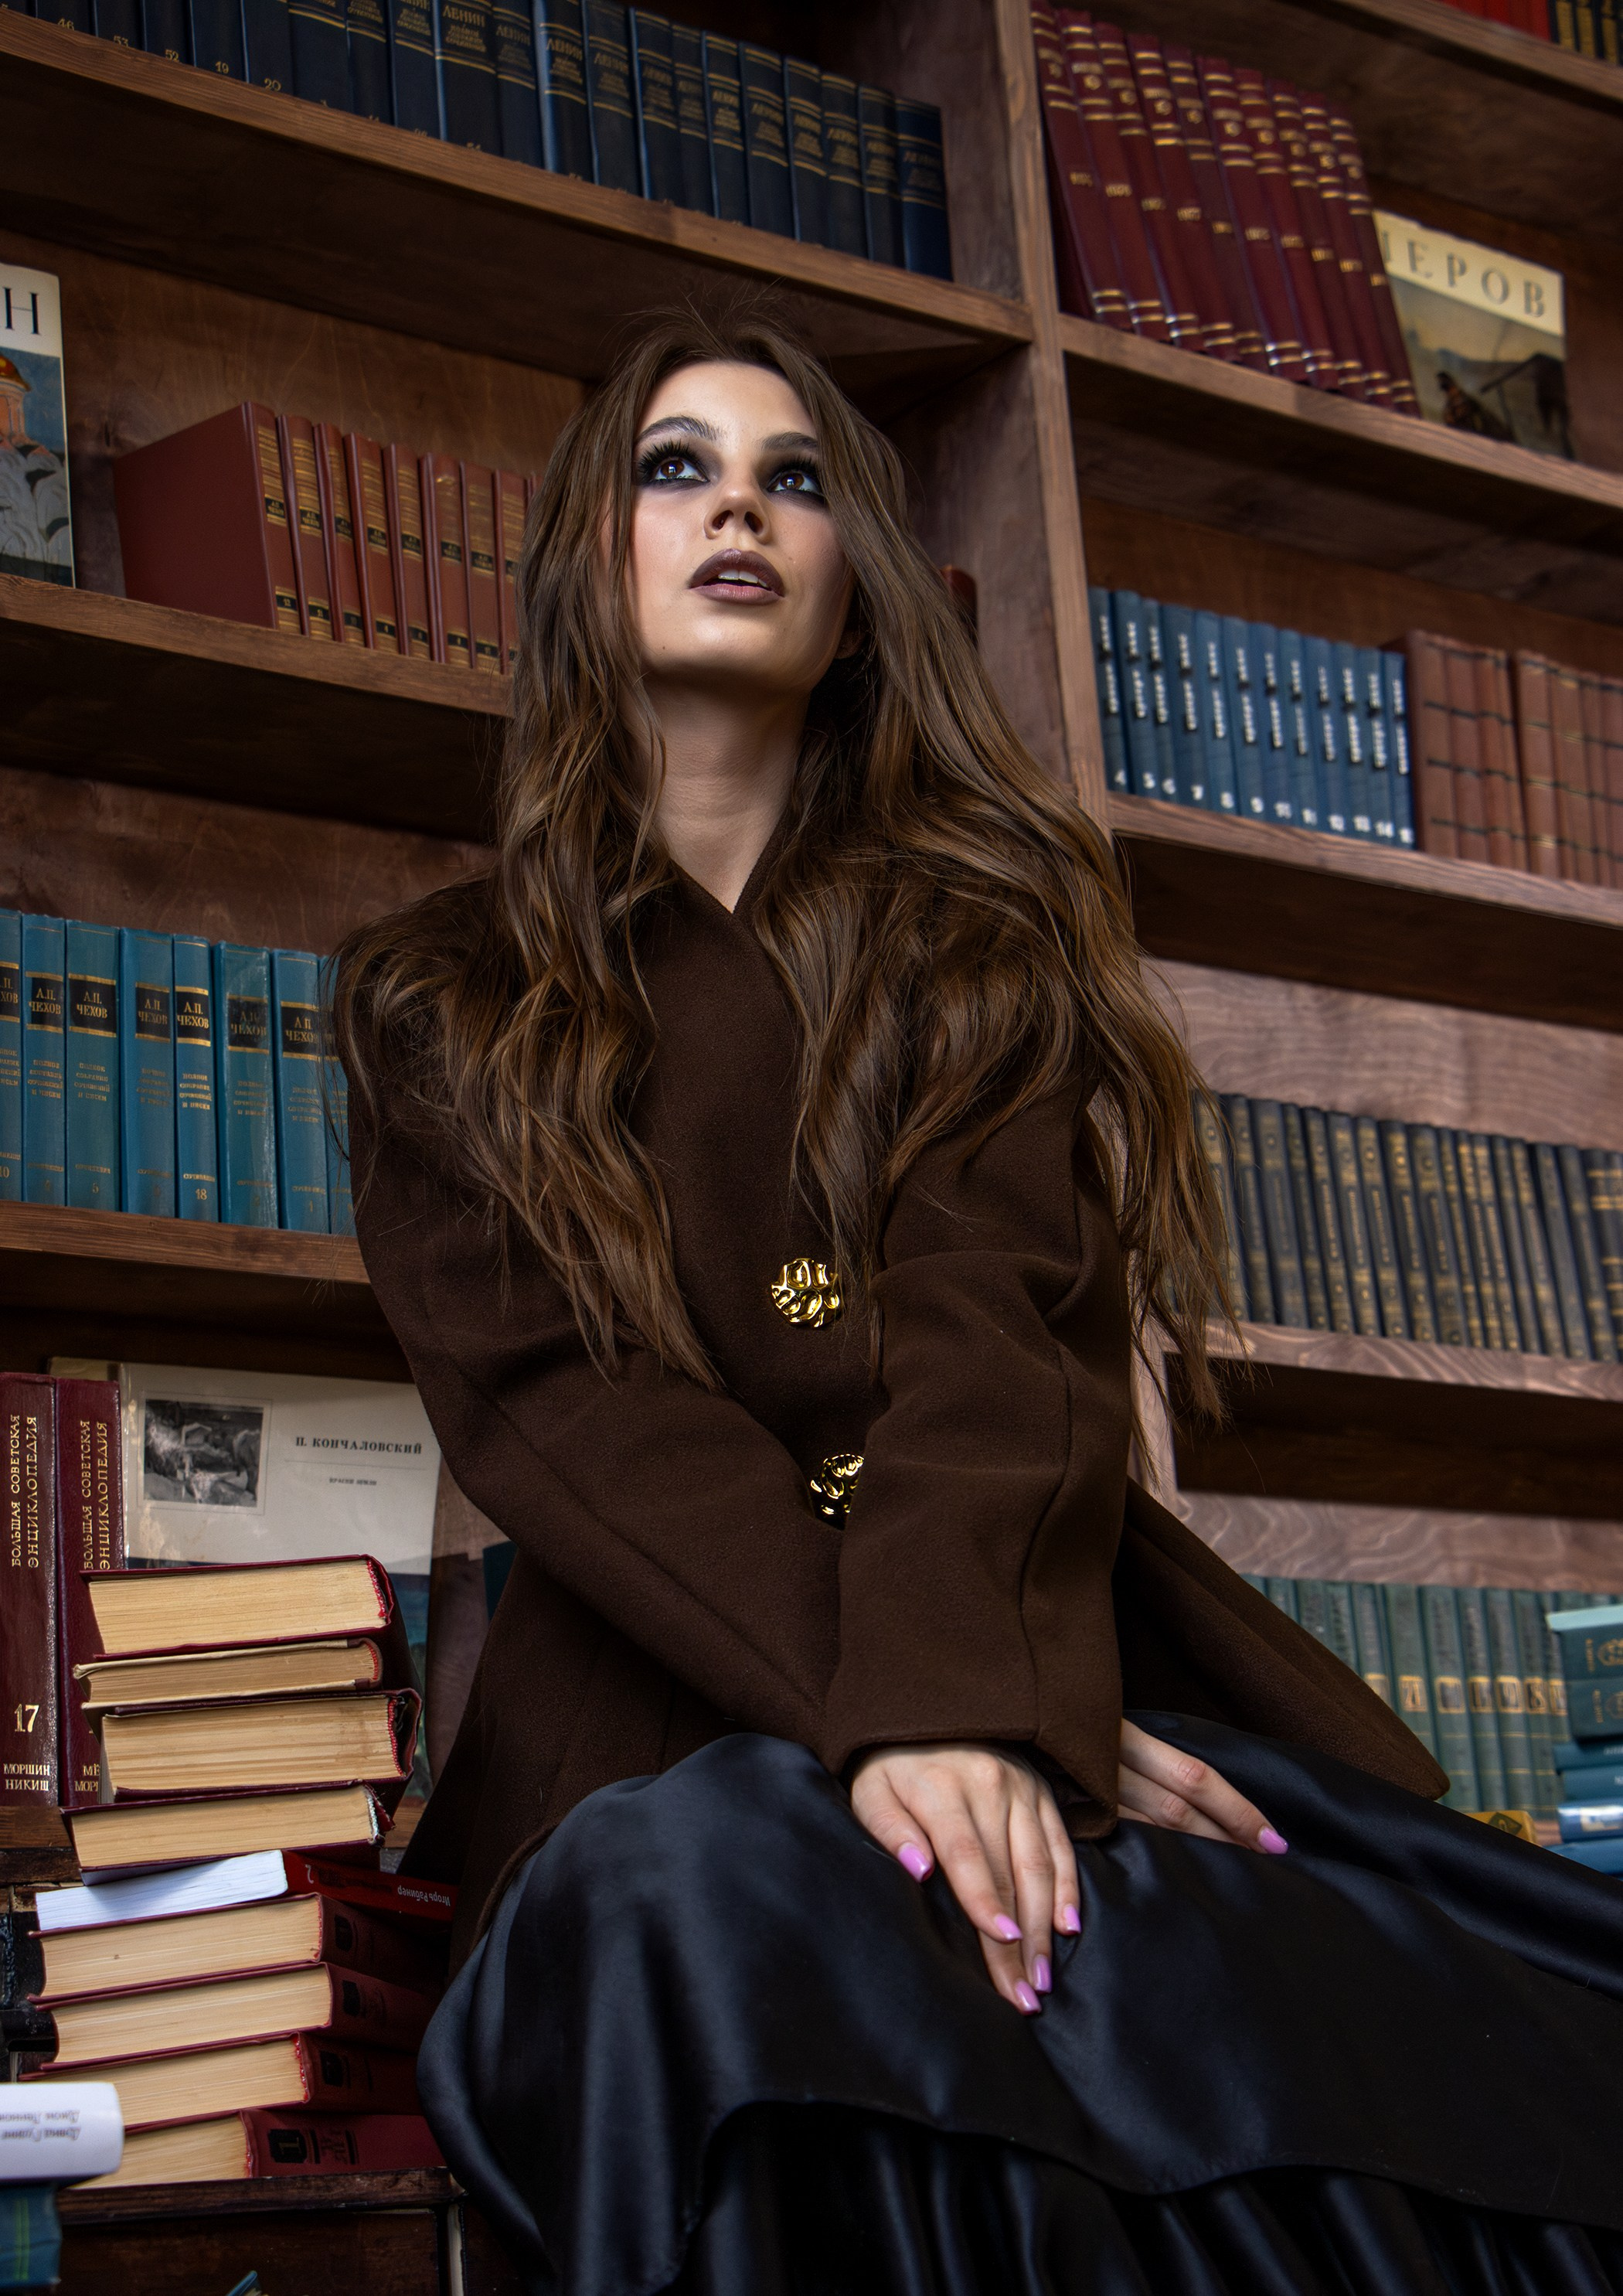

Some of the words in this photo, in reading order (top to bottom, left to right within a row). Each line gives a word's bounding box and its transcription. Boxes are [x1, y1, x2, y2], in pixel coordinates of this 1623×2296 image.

[443, 5, 486, 28] ЛЕНИН
[165, 49, 180, 63] 52
[214, 60, 230, 75] 19
[264, 77, 282, 92] 20
[2, 286, 40, 335] Н
[0, 977, 13, 990] .П.
[0, 992, 19, 1004] ХОВ
[36, 987, 56, 1001] А.П.
[83, 991, 103, 1005] А.П.
[29, 1000, 62, 1015] ЧЕХОВ
[77, 1003, 108, 1019] ЧЕХОВ
[183, 1001, 203, 1015] А.П.
[138, 1010, 168, 1025] ЧЕХОВ
[176, 1014, 209, 1030] ЧЕХОВ
[195, 1188, 208, 1201] 18
[295, 1436, 307, 1447] П.
[312, 1438, 423, 1455] КОНЧАЛОВСКИЙ
[10, 1414, 21, 1494] СОВЕТСКАЯ
[80, 1419, 92, 1498] СОВЕТСКАЯ
[26, 1415, 39, 1569] ЭНЦИКЛОПЕДИЯ
[97, 1421, 111, 1570] ЭНЦИКЛОПЕДИЯ
[11, 1501, 22, 1568] БОЛЬШАЯ
[82, 1504, 94, 1570] БОЛЬШАЯ
[14, 1703, 39, 1733] 17
[3, 1763, 50, 1777] МОРШИН
[83, 1763, 100, 1777] МЁ
[5, 1779, 49, 1792] НИКИШ
[74, 1780, 99, 1792] МОР
[397, 1885, 429, 1903] Рабинер
[428, 1891, 451, 1907] Игорь
[277, 2136, 303, 2155] 1
